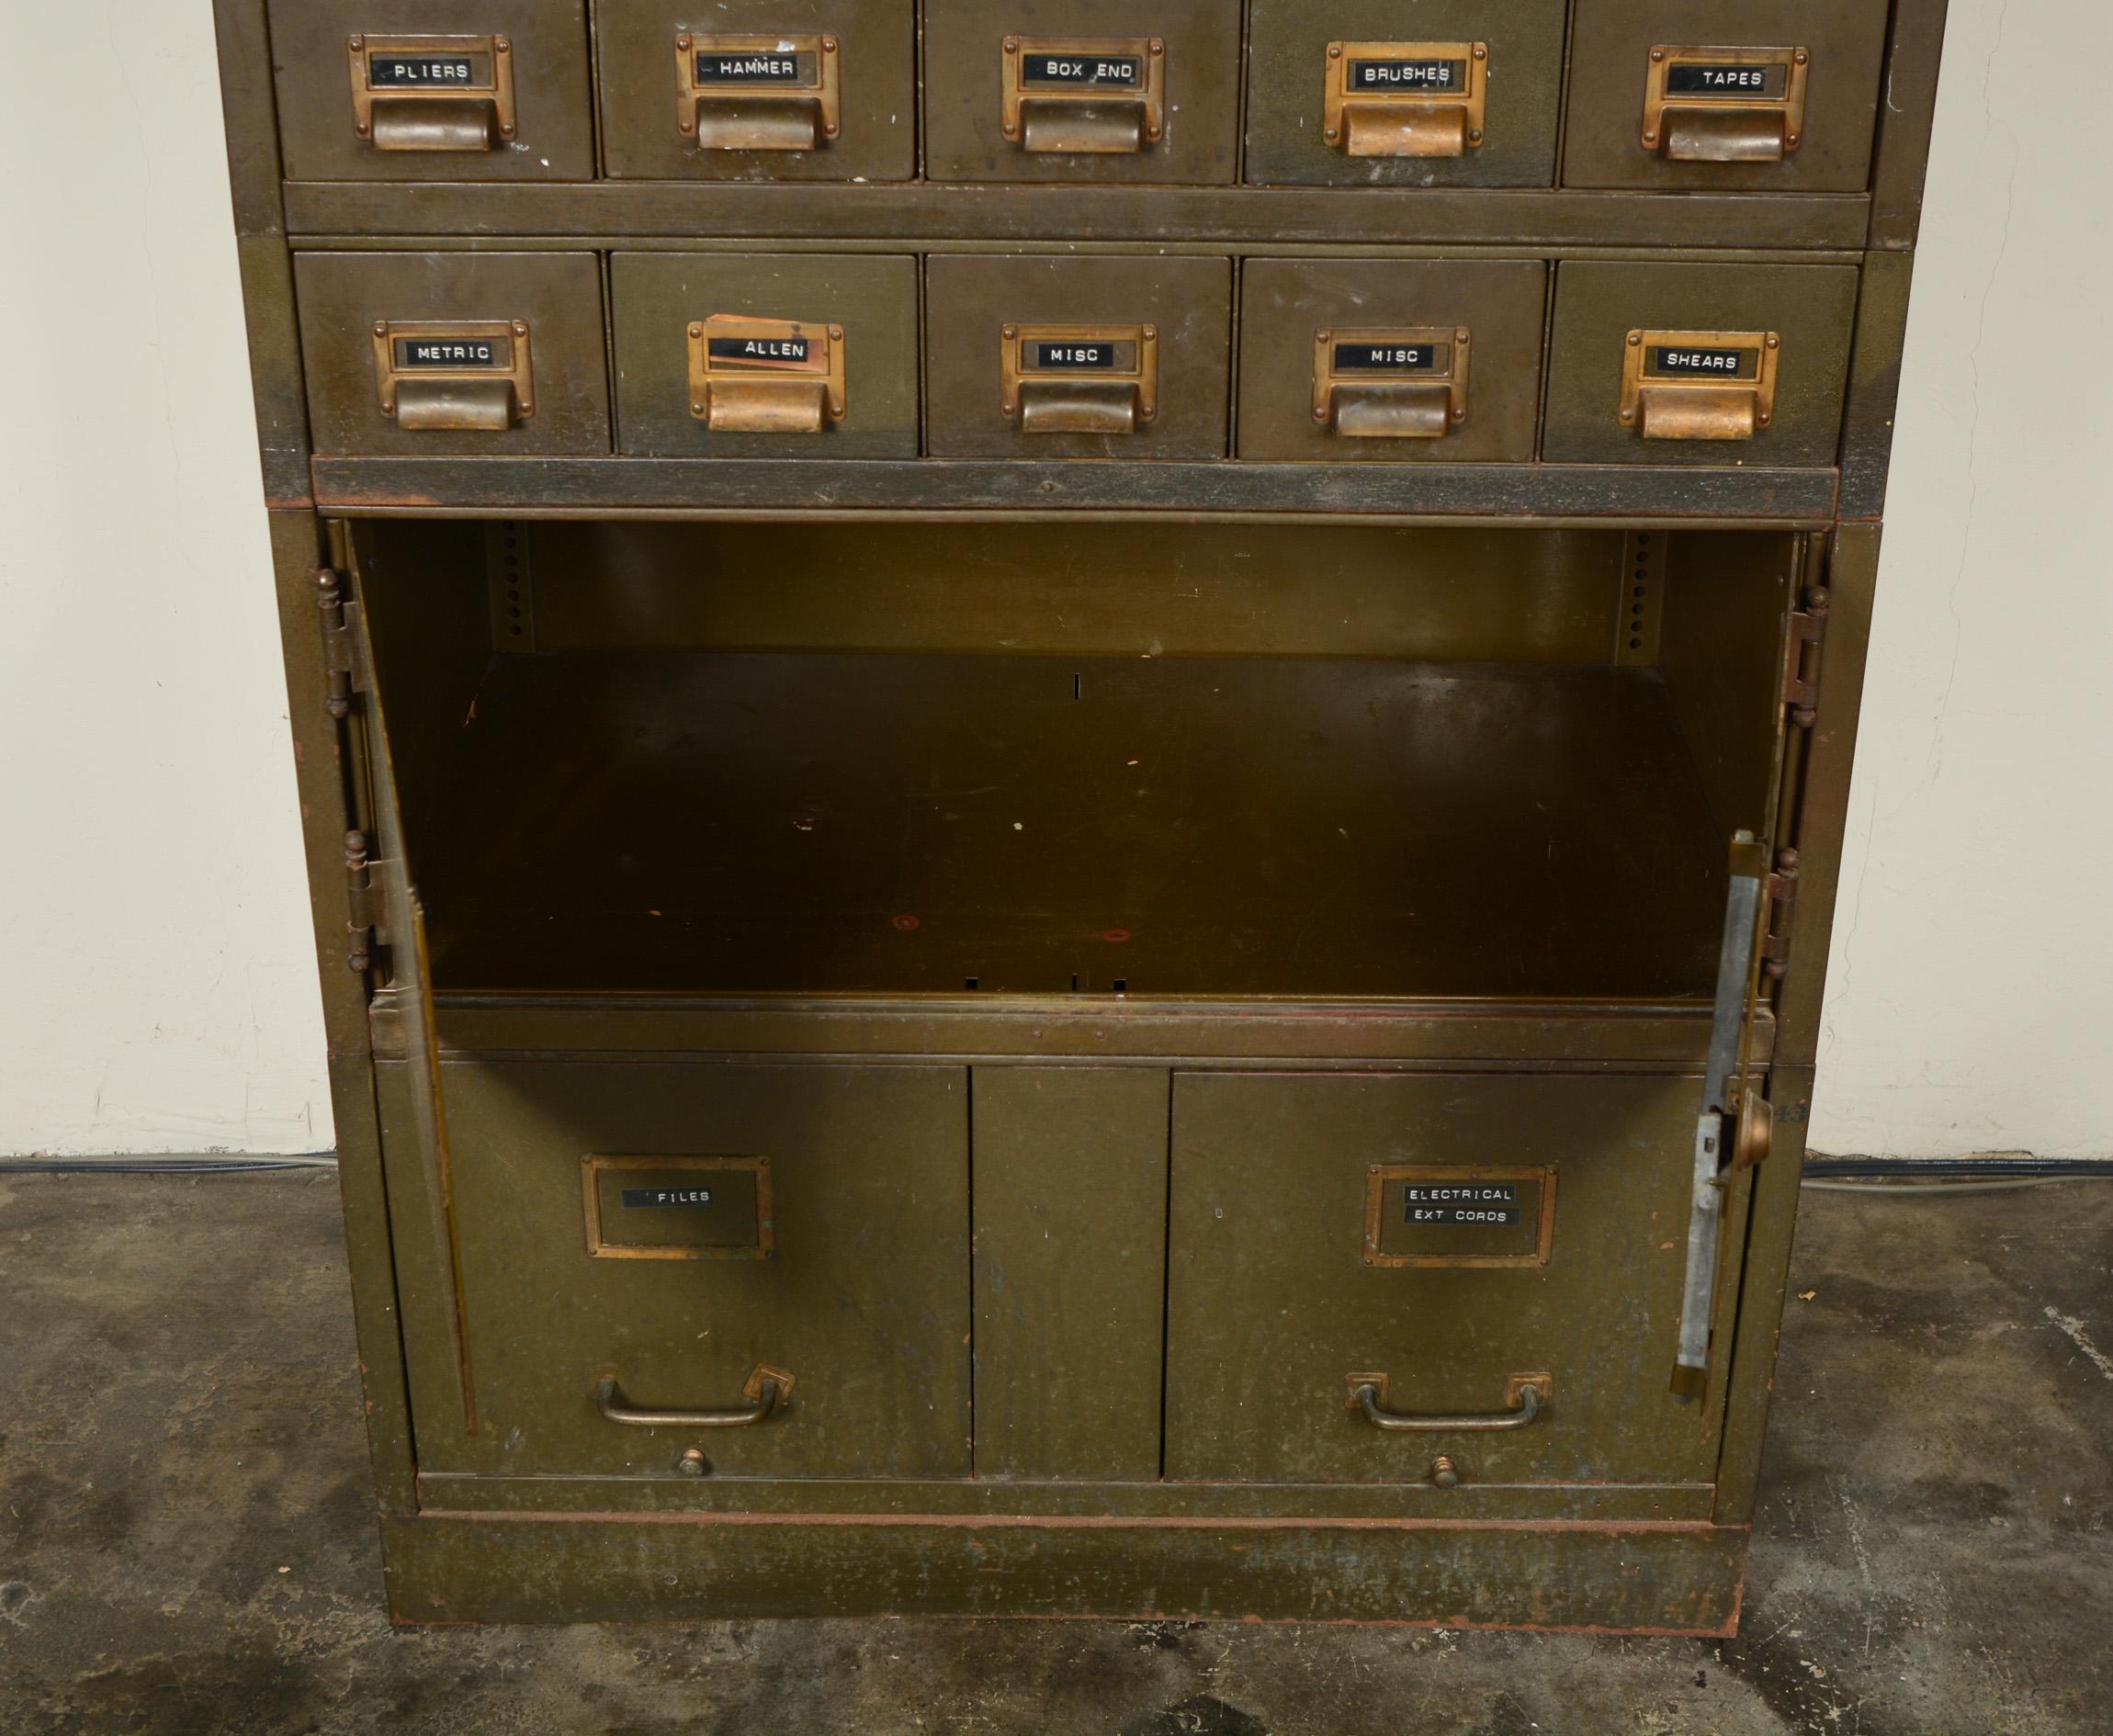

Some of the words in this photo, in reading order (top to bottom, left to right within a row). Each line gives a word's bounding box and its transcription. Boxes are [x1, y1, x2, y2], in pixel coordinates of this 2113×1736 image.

[394, 64, 469, 79] PLIERS
[720, 58, 793, 74] HAMMER
[1046, 61, 1083, 76] BOX
[1095, 62, 1134, 77] END
[1363, 67, 1450, 83] BRUSHES
[1702, 72, 1762, 85] TAPES
[417, 346, 490, 359] METRIC
[745, 341, 804, 357] ALLEN
[1051, 348, 1097, 362] MISC
[1371, 350, 1418, 363] MISC
[1667, 353, 1736, 369] SHEARS
[658, 1190, 710, 1203] FILES
[1408, 1189, 1512, 1201] ELECTRICAL
[1413, 1209, 1445, 1221] EXT
[1454, 1210, 1508, 1223] CORDS
